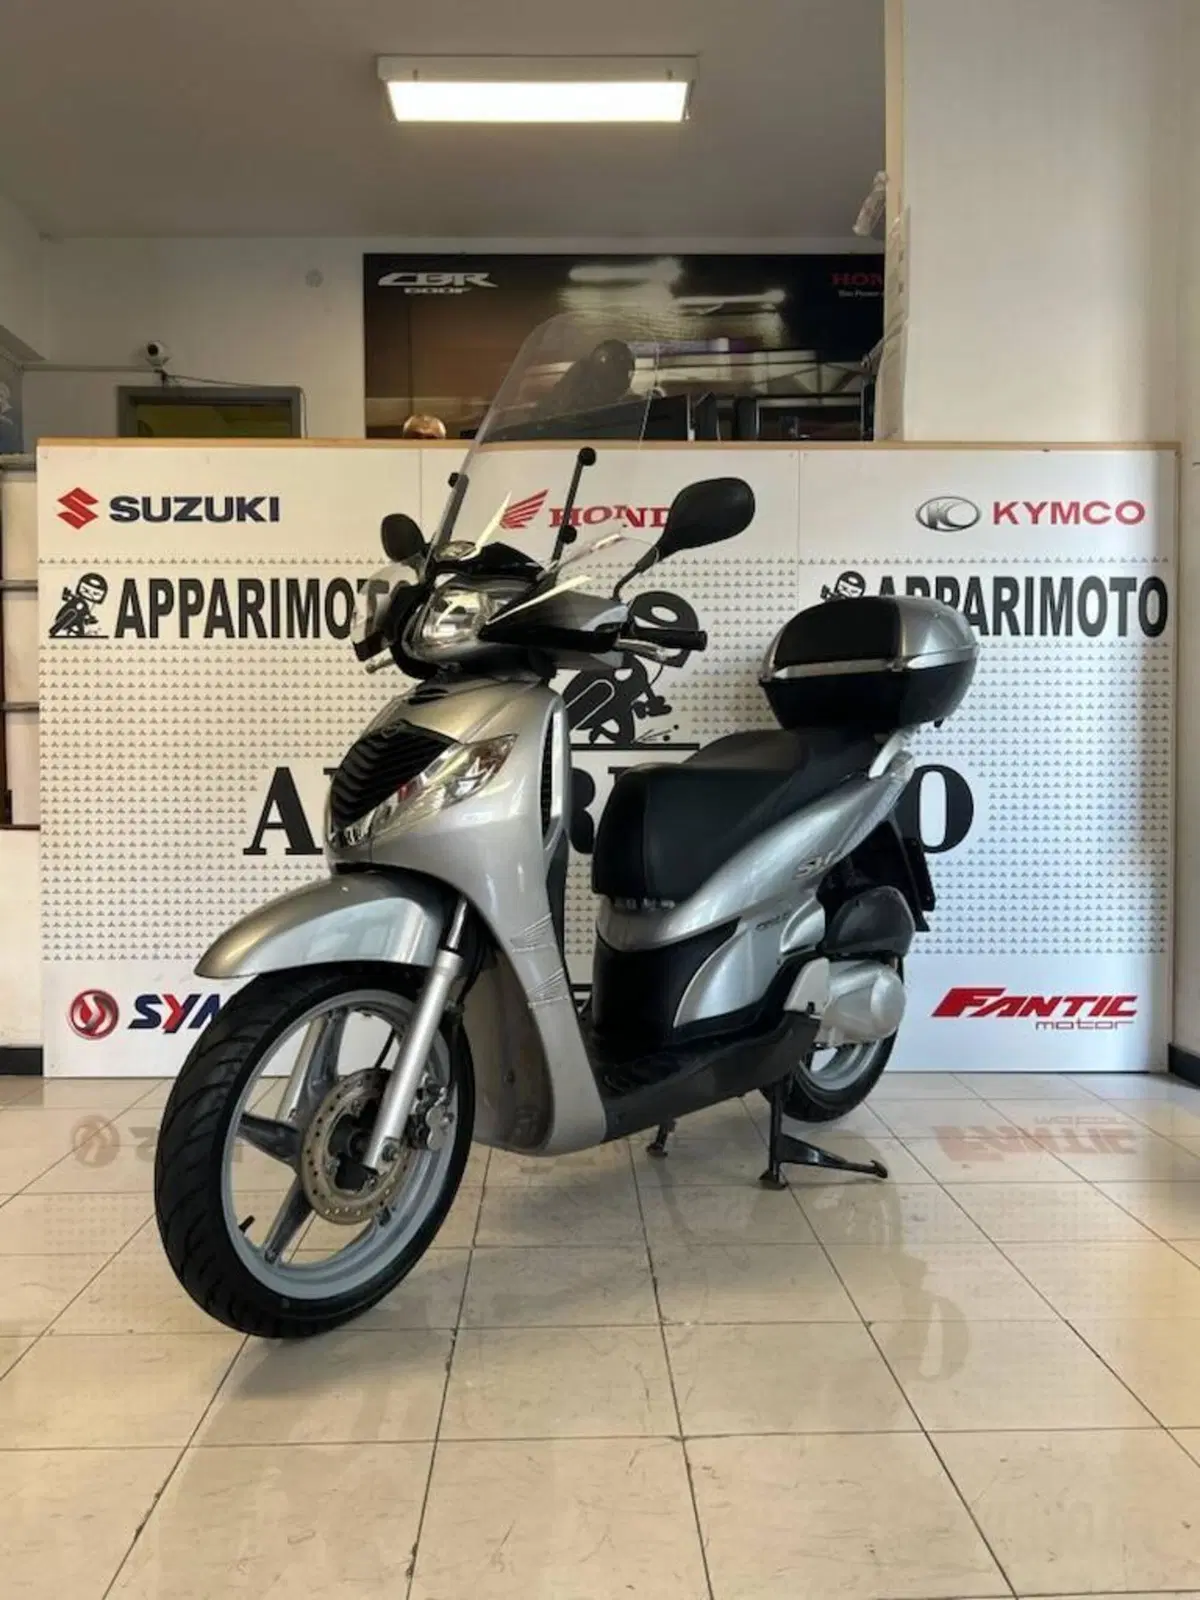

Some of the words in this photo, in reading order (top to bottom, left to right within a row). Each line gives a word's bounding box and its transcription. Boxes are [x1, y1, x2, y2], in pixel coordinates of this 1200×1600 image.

[377, 272, 498, 287] CBR
[109, 495, 280, 523] SUZUKI
[993, 500, 1146, 526] KYMCO
[114, 577, 411, 640] APPARIMOT
[931, 987, 1139, 1018] FANTIC
[1035, 1017, 1135, 1031] motor
